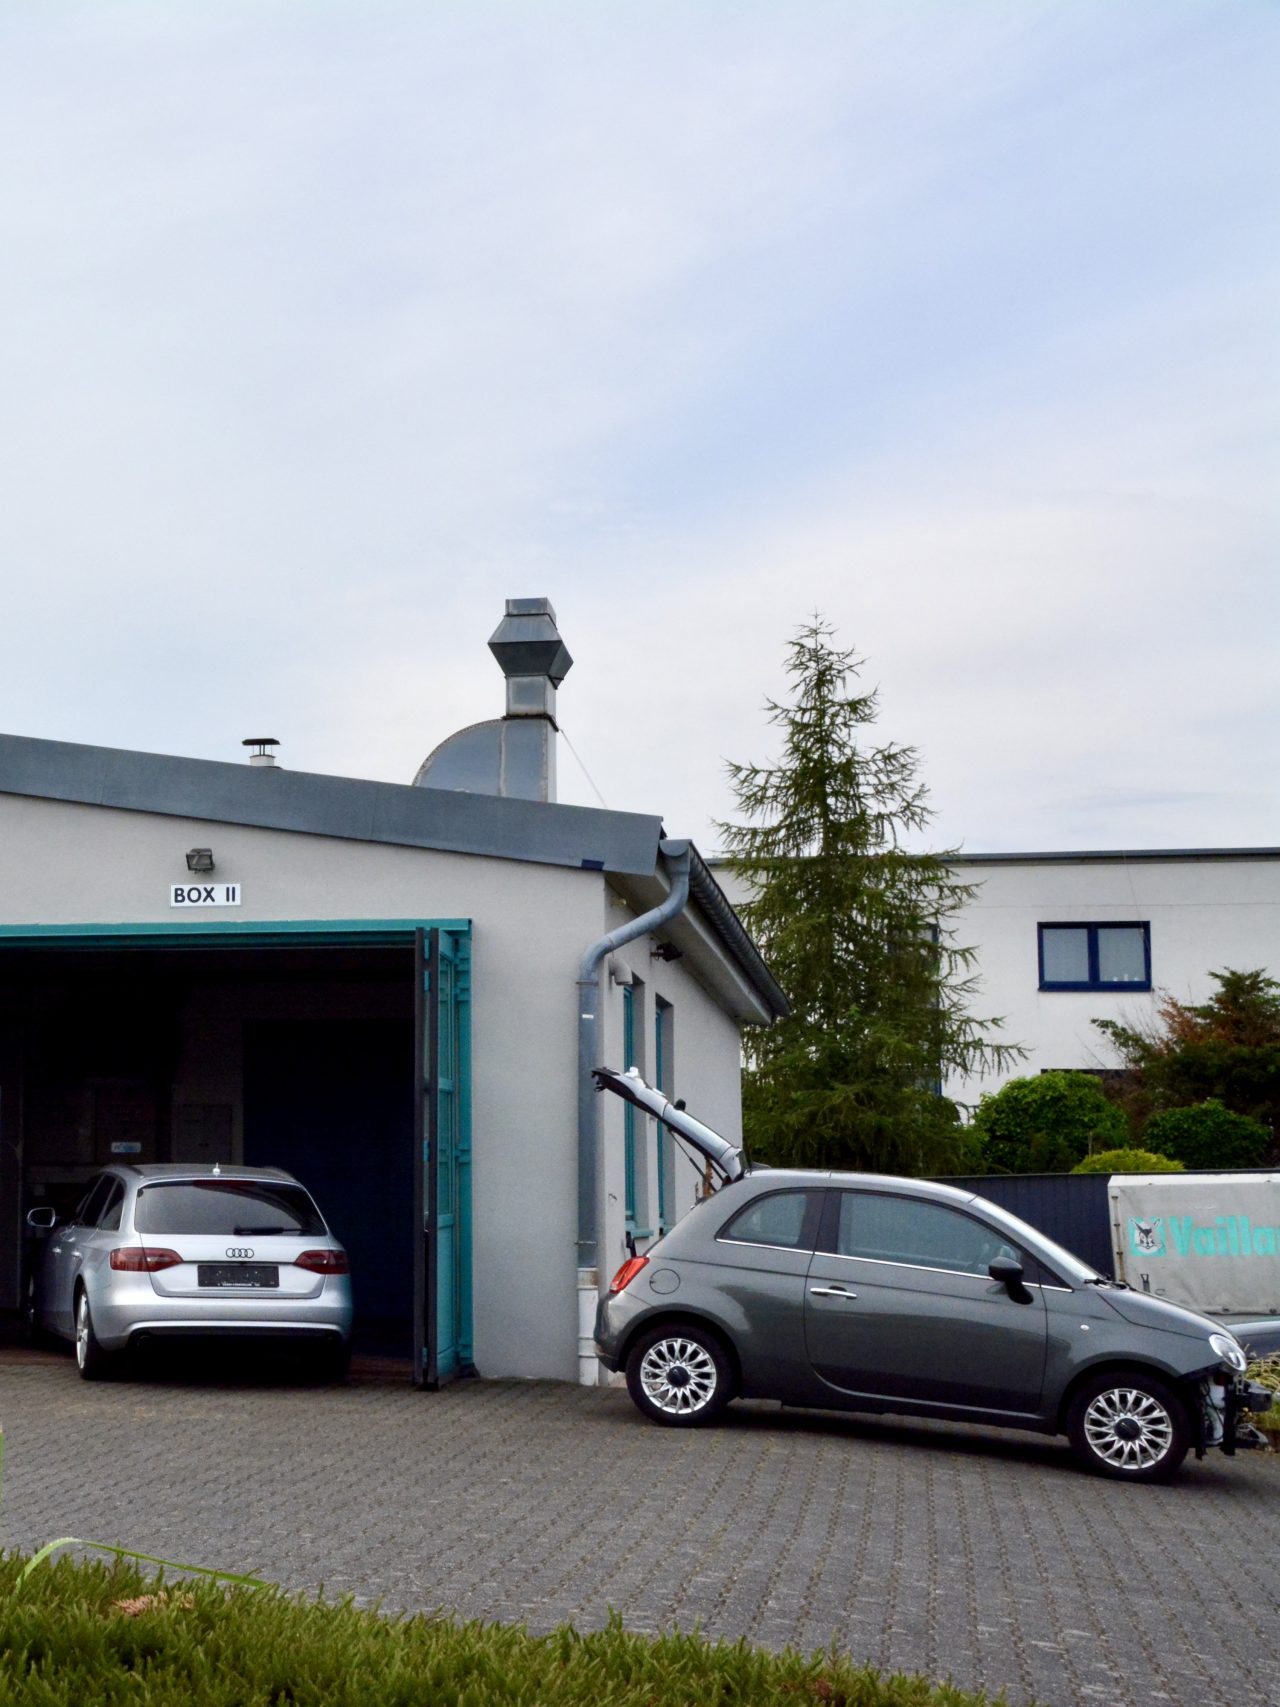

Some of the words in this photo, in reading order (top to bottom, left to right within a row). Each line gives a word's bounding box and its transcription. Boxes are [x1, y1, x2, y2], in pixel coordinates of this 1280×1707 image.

[174, 886, 216, 903] BOX
[226, 886, 236, 902] II
[1168, 1215, 1280, 1257] Vailla
